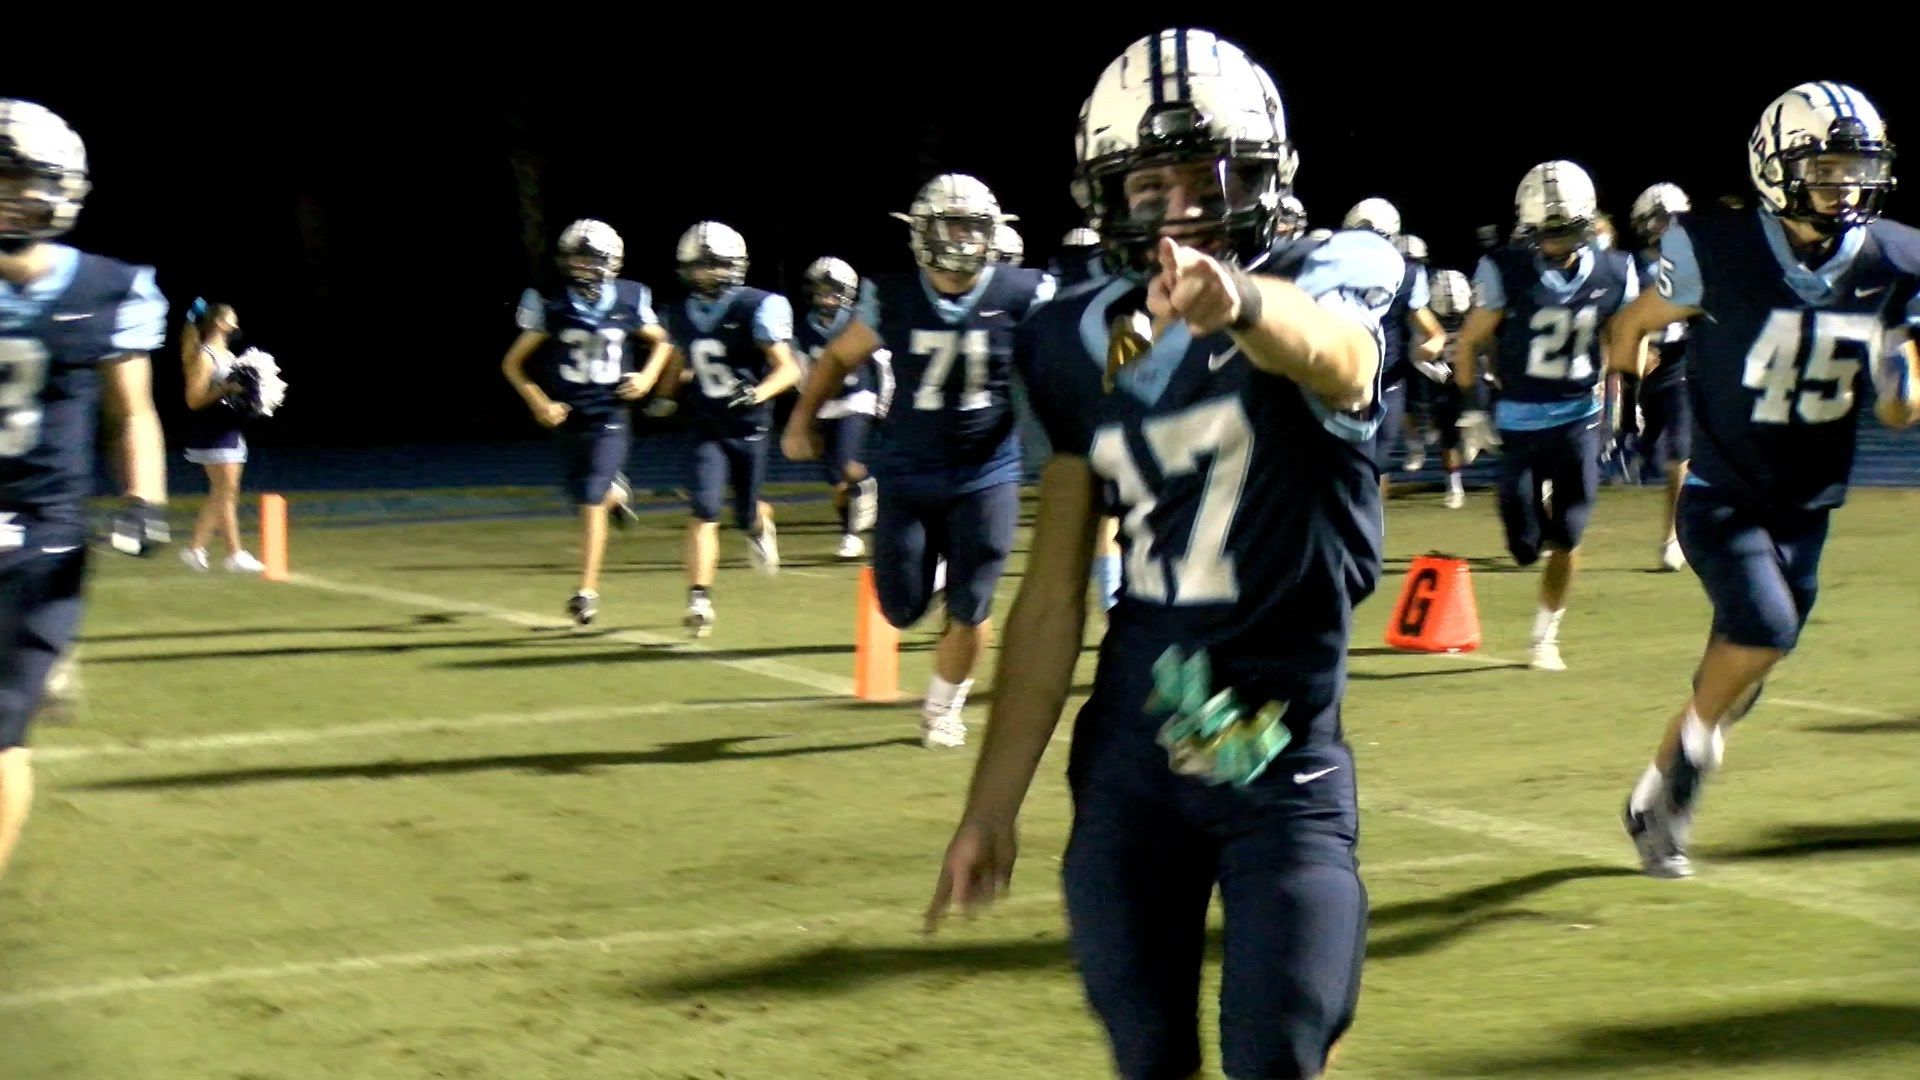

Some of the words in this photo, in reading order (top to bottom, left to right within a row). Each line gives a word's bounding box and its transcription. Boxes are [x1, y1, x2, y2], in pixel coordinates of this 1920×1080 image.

[558, 327, 626, 385] 30
[690, 338, 741, 399] 6
[911, 329, 993, 411] 71
[1525, 306, 1599, 379] 21
[1741, 309, 1880, 424] 45
[1089, 395, 1255, 606] 17
[1399, 567, 1438, 637] G
